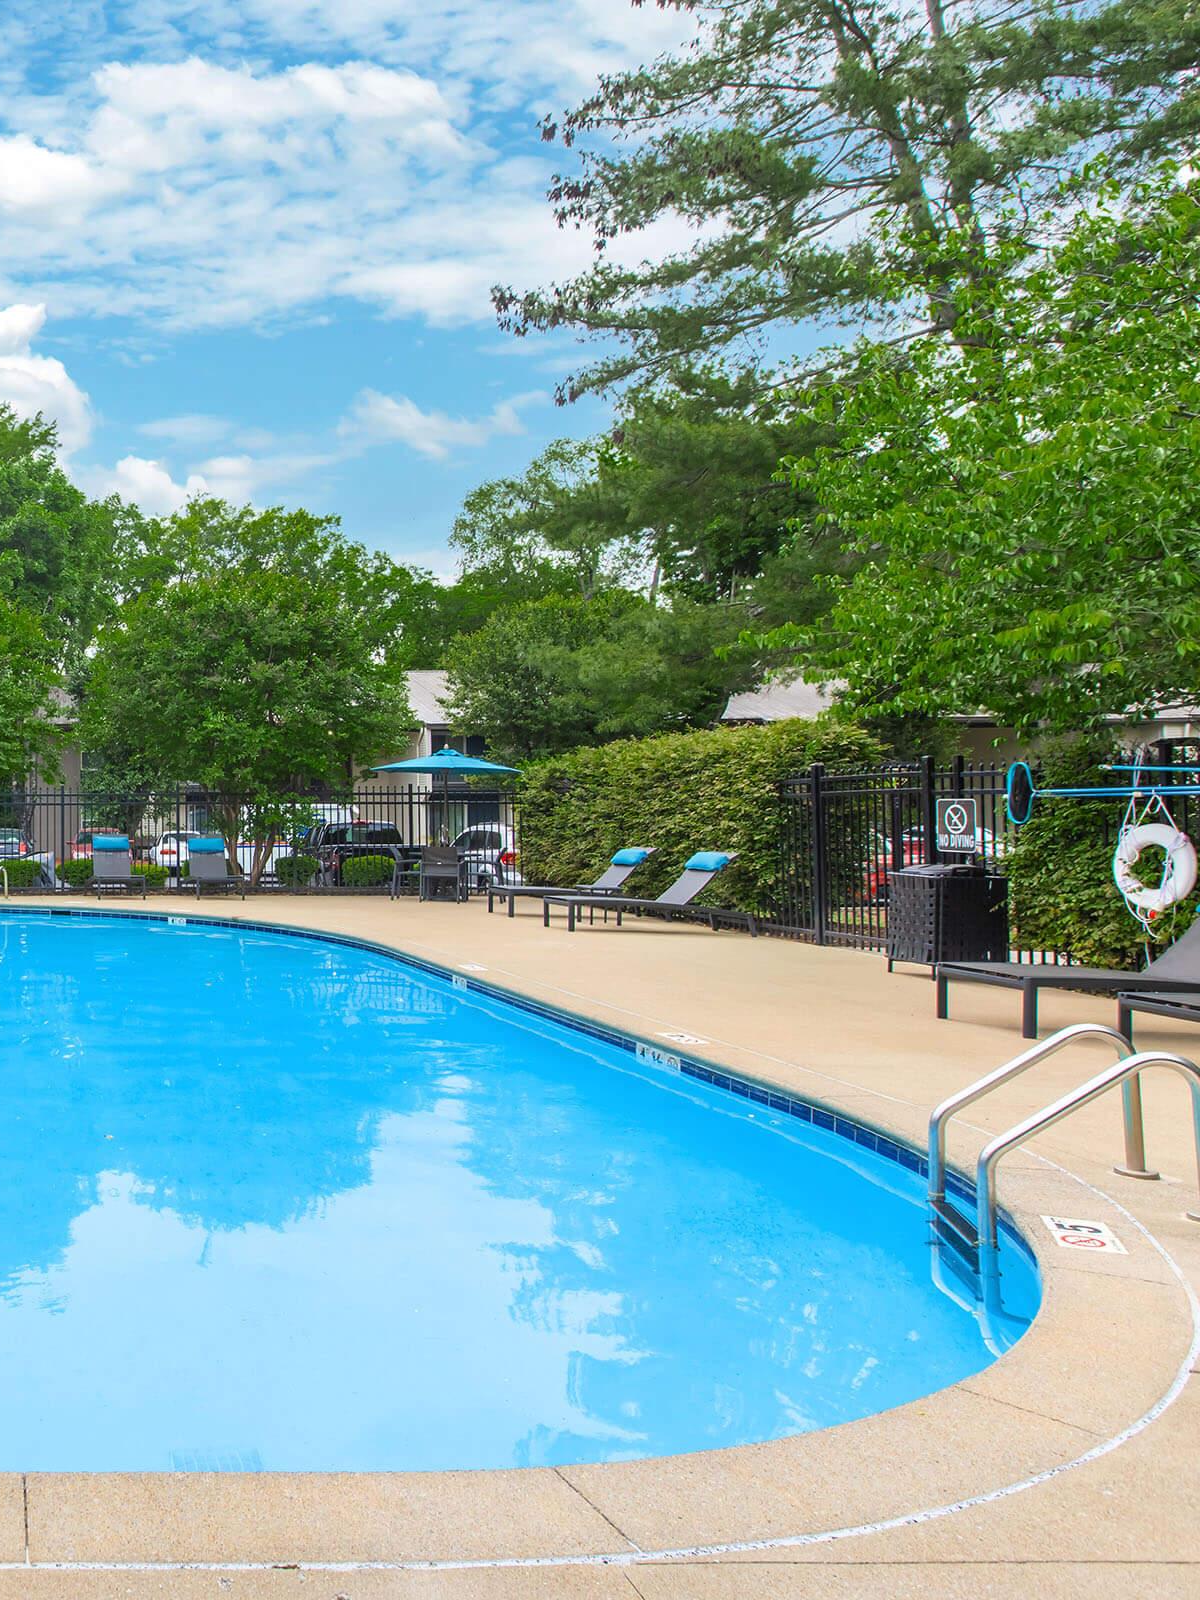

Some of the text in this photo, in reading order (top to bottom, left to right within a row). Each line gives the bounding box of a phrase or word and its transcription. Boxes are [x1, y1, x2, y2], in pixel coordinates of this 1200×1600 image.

[938, 834, 975, 849] NO DIVING
[1055, 1223, 1102, 1234] 5
